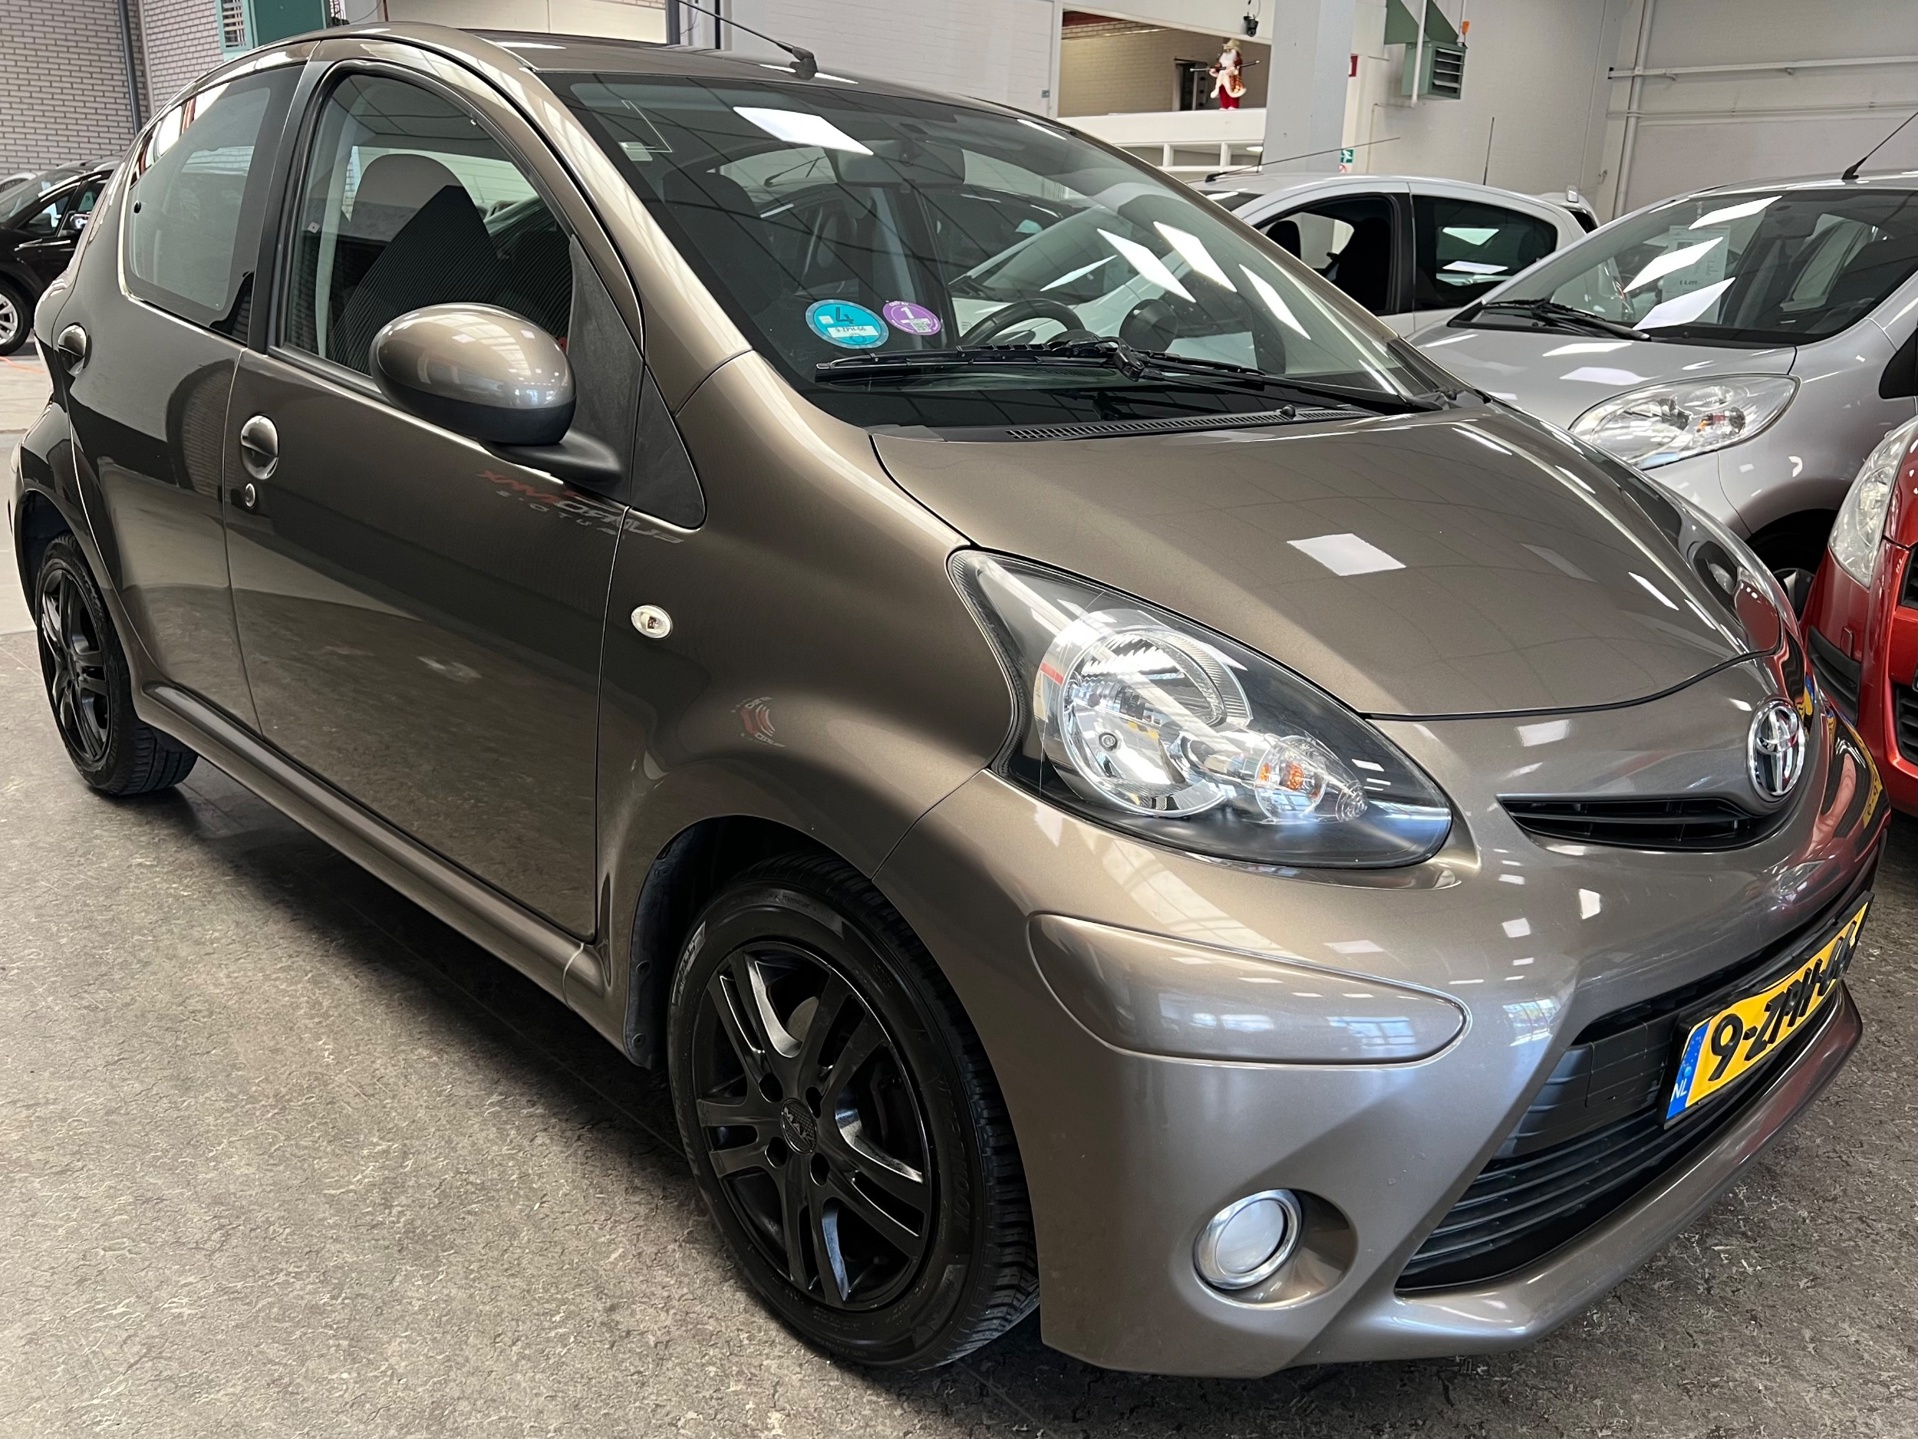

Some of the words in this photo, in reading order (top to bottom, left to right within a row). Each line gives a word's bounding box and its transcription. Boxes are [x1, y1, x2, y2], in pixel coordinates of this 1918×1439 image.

[837, 307, 854, 324] 4
[901, 306, 914, 318] 1
[1672, 1082, 1687, 1101] NL
[783, 1106, 815, 1146] MAK
